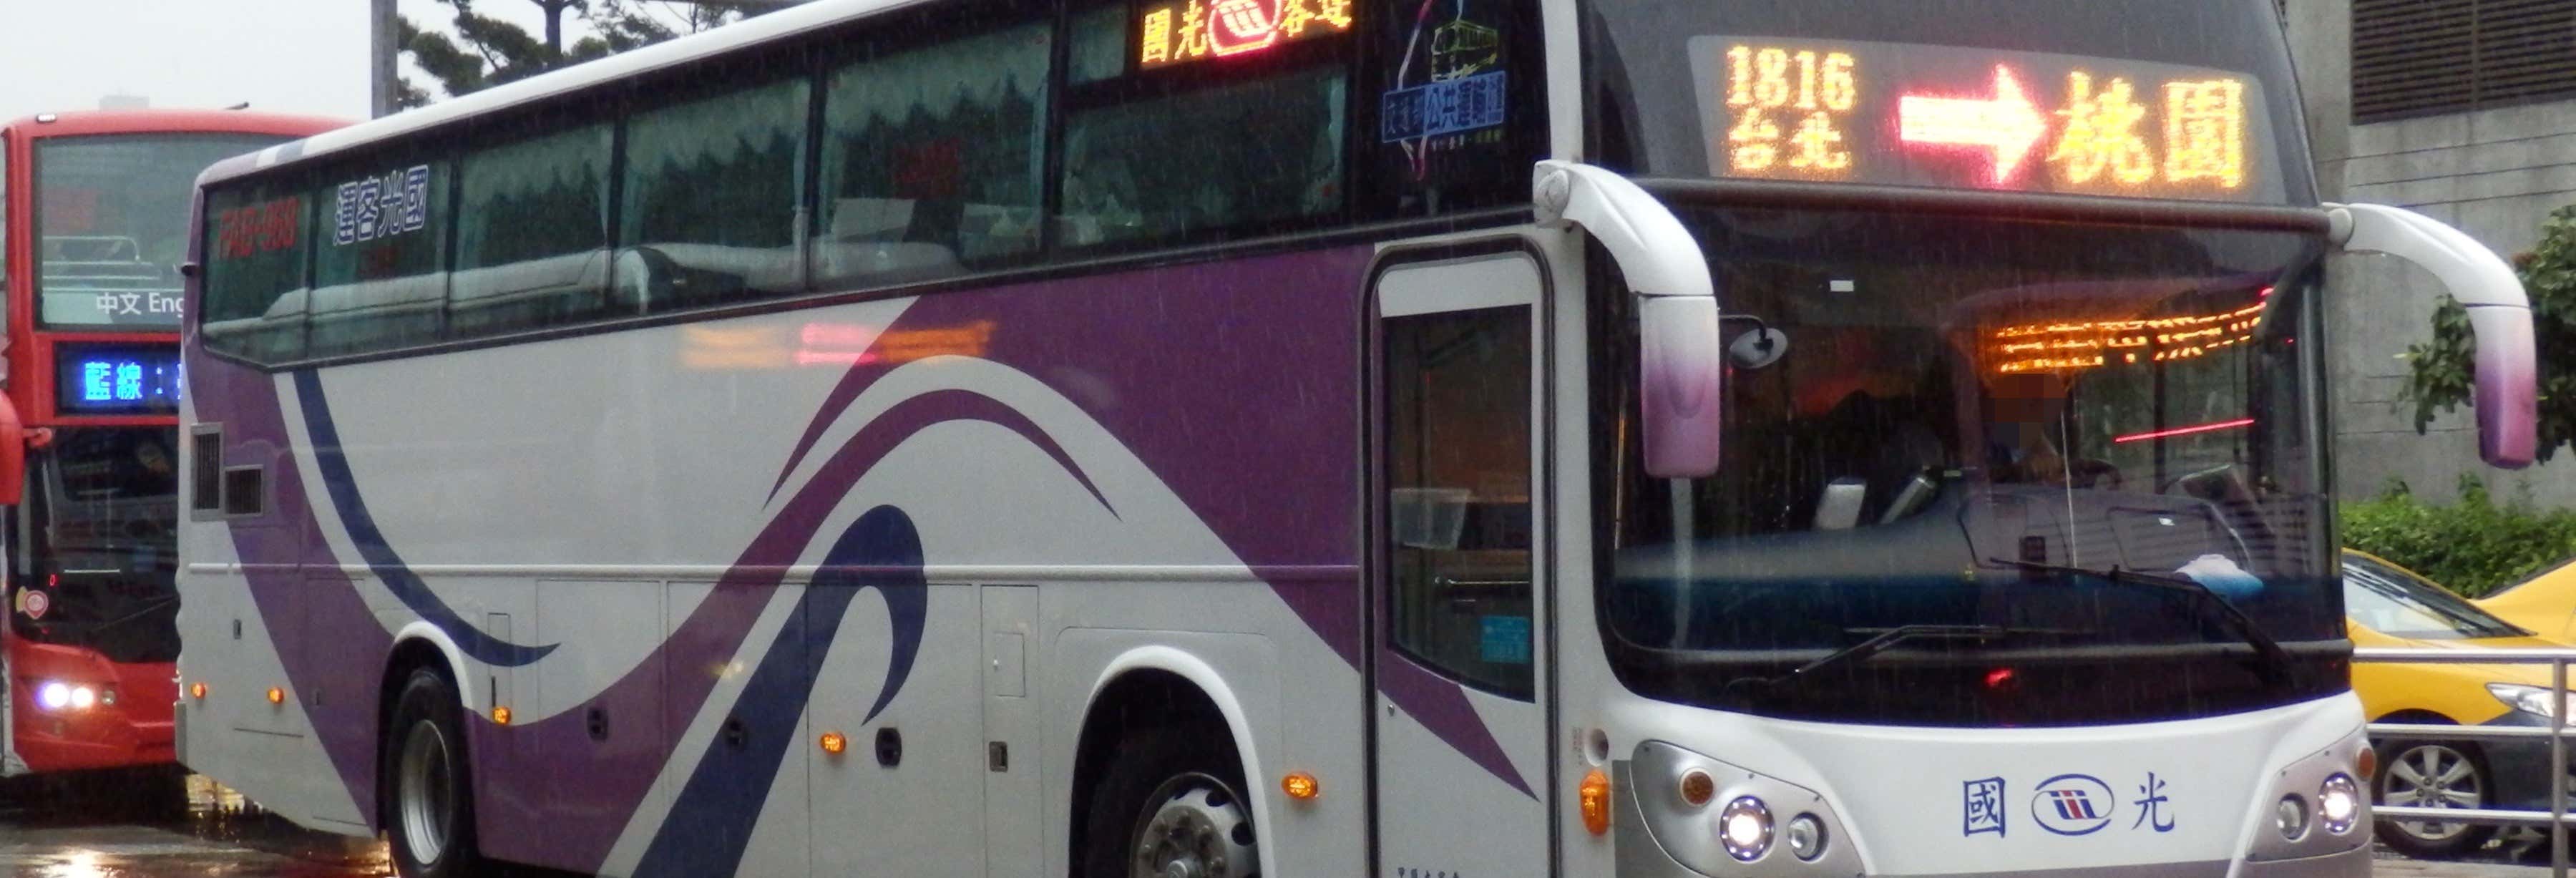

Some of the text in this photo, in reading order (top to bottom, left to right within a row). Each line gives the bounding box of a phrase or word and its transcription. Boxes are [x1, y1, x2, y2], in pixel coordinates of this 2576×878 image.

[1142, 0, 1207, 62] 國光
[1726, 46, 1855, 109] 1816
[1729, 107, 1851, 169] 台北
[2045, 71, 2243, 188] 桃園
[97, 292, 185, 318] 中文 Eng
[1963, 771, 2175, 838] 國 光
